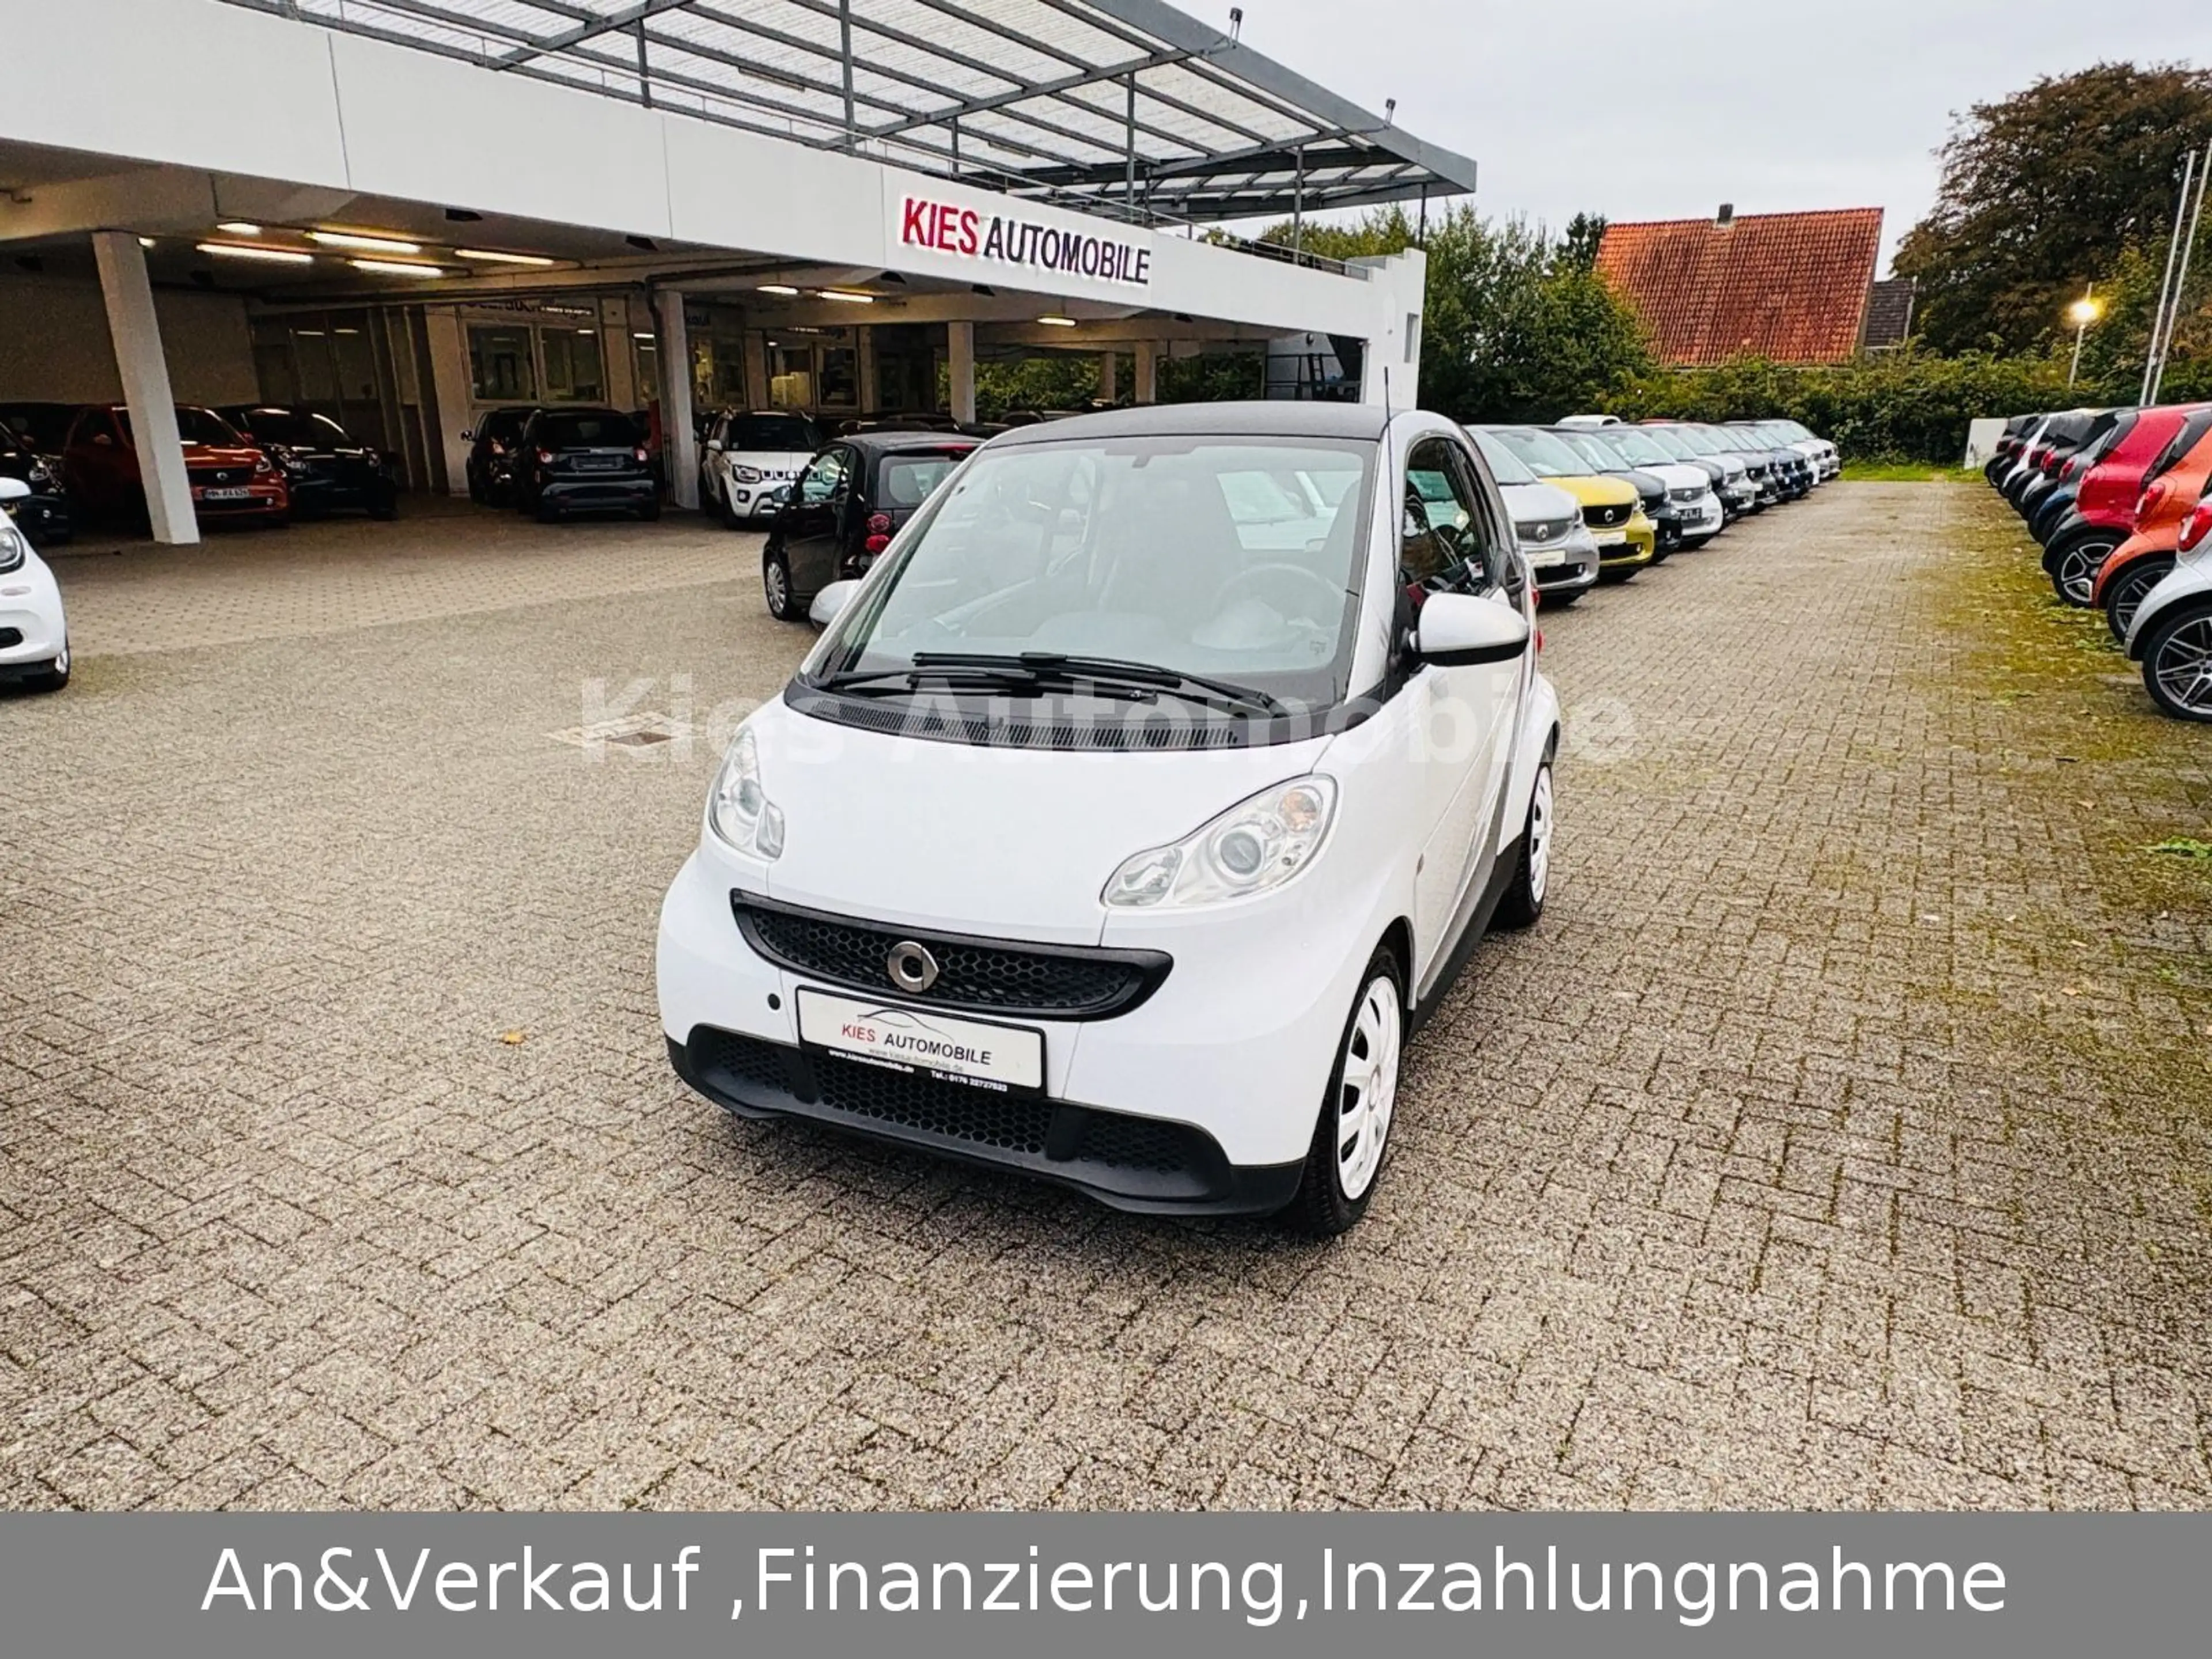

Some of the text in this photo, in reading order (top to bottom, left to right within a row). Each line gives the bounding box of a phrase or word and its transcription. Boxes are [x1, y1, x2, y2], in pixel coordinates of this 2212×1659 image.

[902, 198, 1151, 284] KIES AUTOMOBILE
[842, 1024, 992, 1065] KIES AUTOMOBILE
